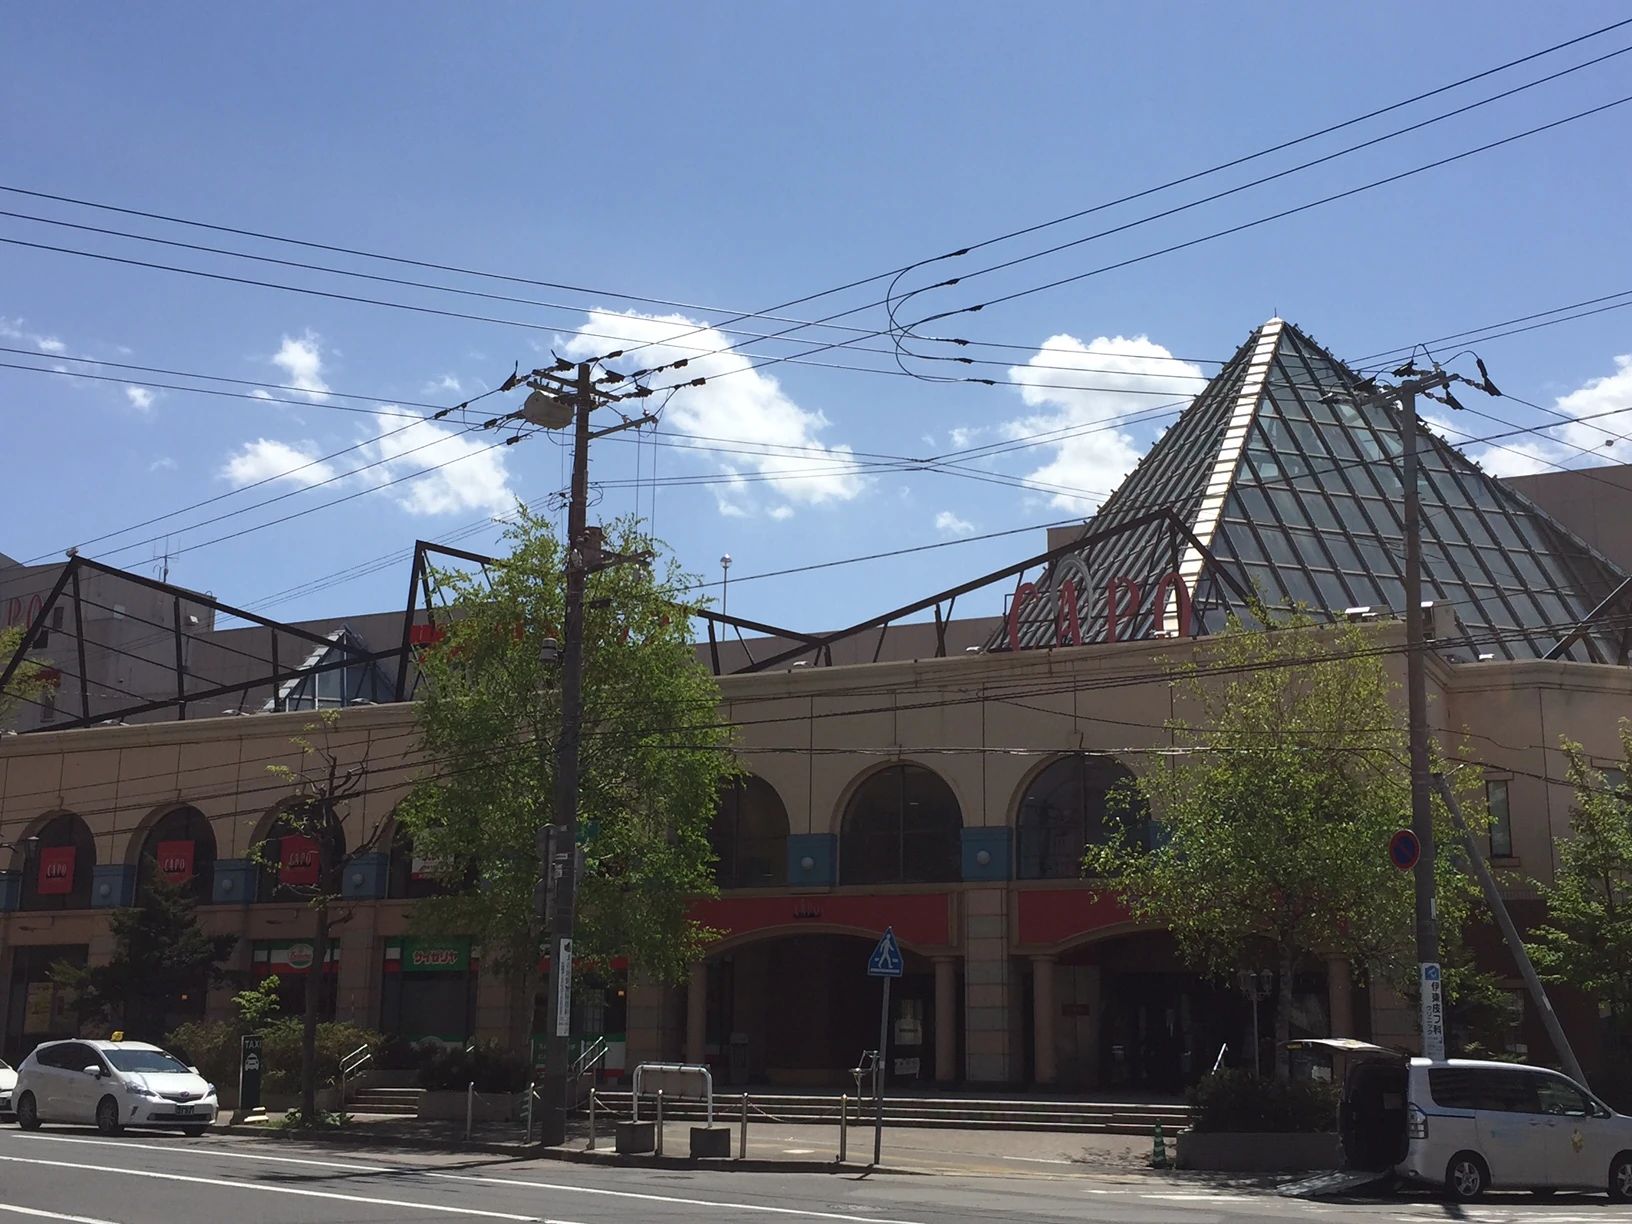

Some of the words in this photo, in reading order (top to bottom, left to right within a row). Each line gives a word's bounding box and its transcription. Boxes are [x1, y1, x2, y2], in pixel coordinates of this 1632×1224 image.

[1008, 572, 1192, 652] CAPO
[412, 949, 459, 965] サイゼリヤ
[244, 1039, 262, 1049] TAXI
